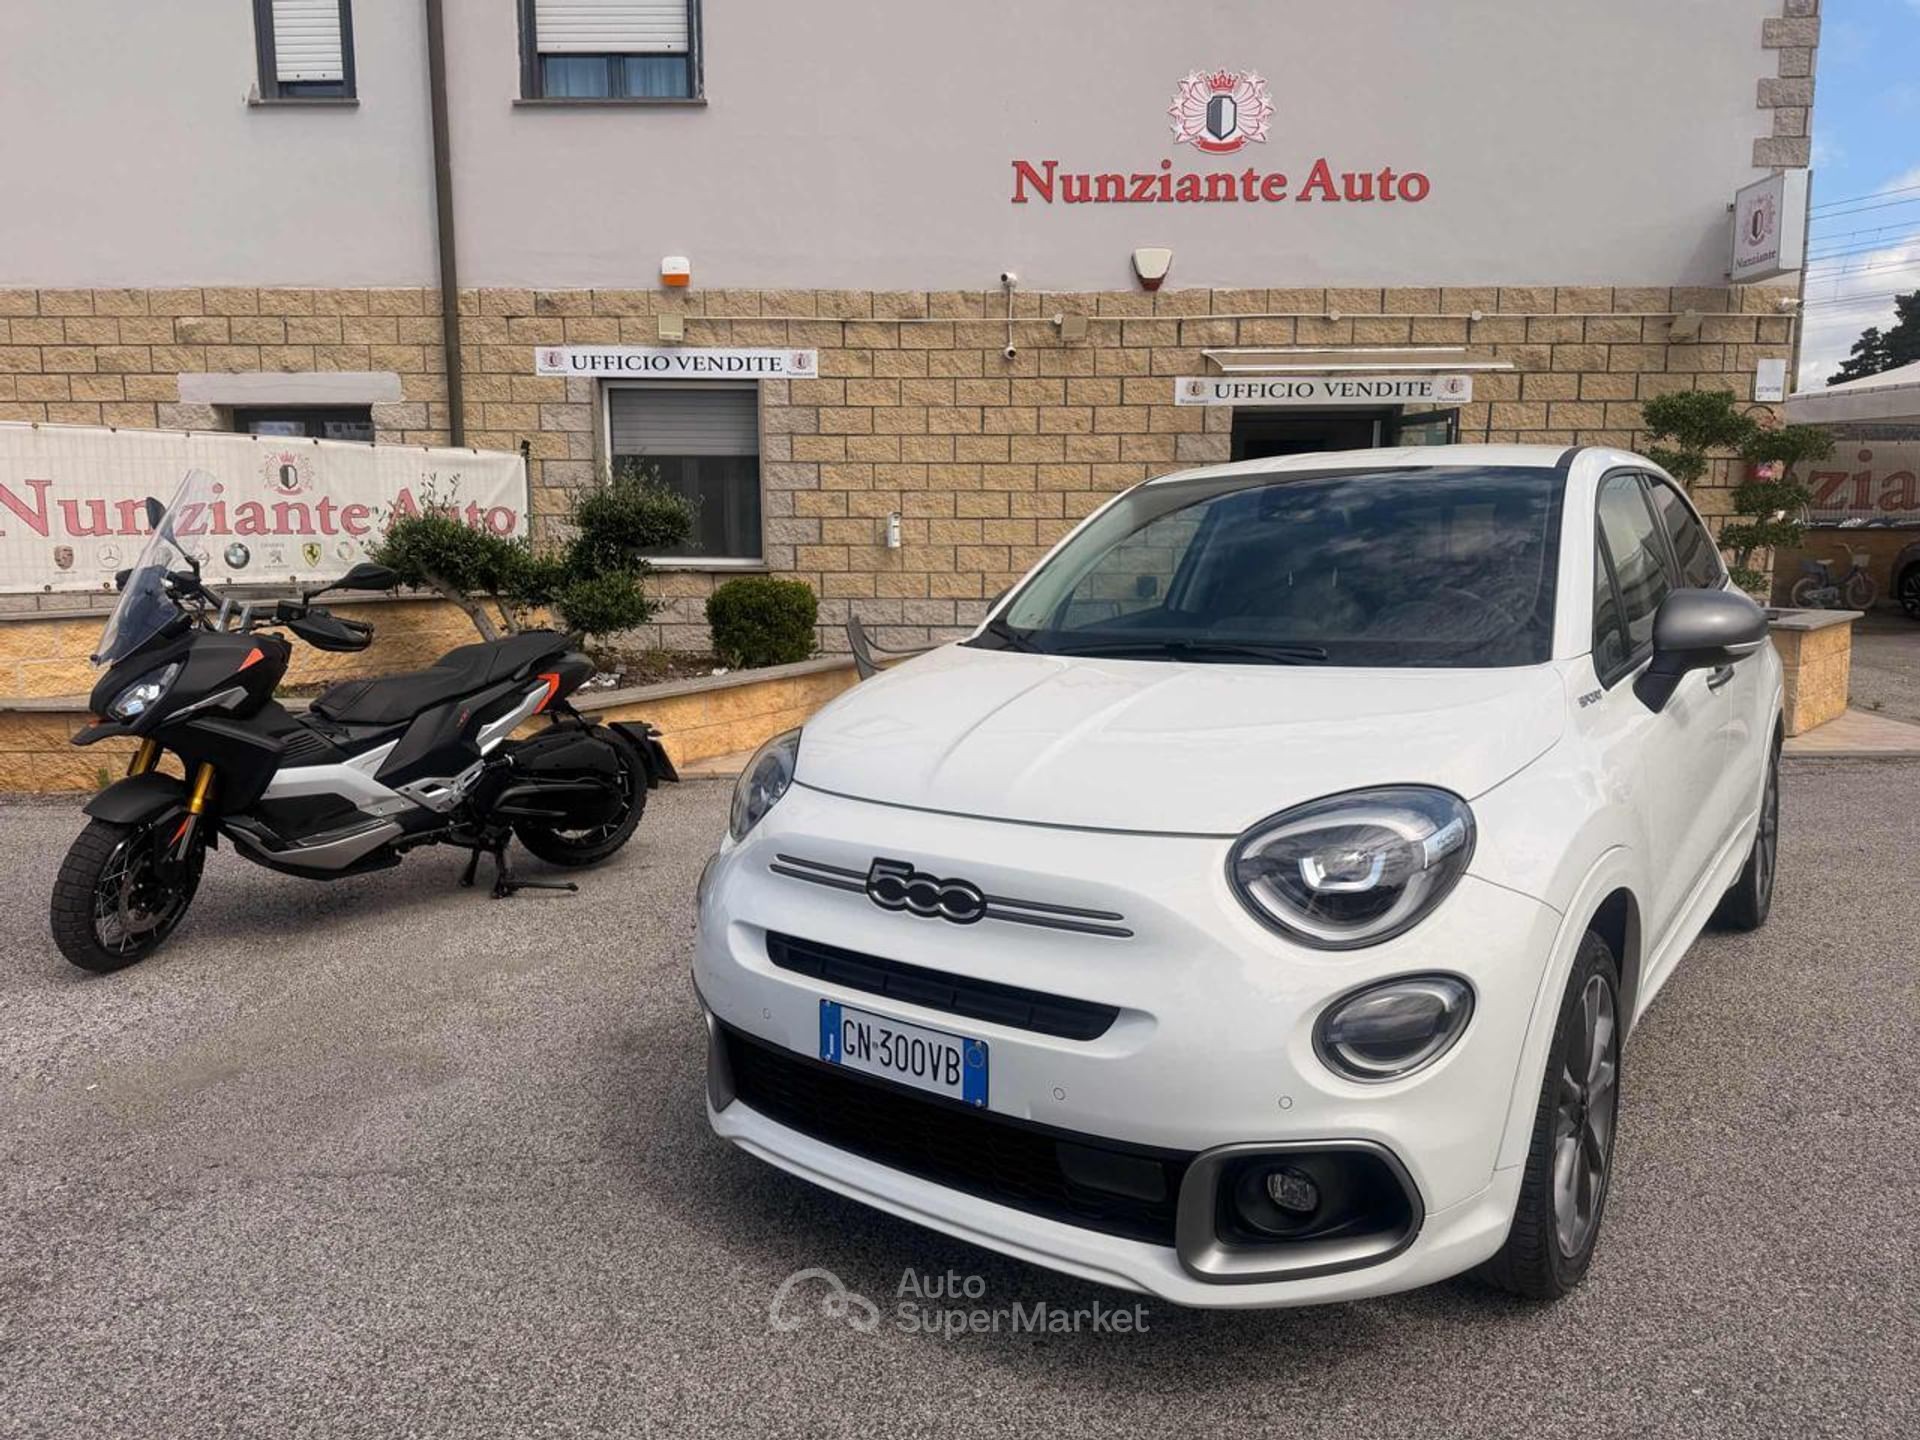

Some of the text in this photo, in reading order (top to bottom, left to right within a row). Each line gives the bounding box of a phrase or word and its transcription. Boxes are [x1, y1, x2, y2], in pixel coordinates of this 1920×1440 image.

[1011, 158, 1430, 203] Nunziante Auto
[571, 354, 783, 372] UFFICIO VENDITE
[1214, 381, 1433, 399] UFFICIO VENDITE
[867, 858, 987, 925] 500
